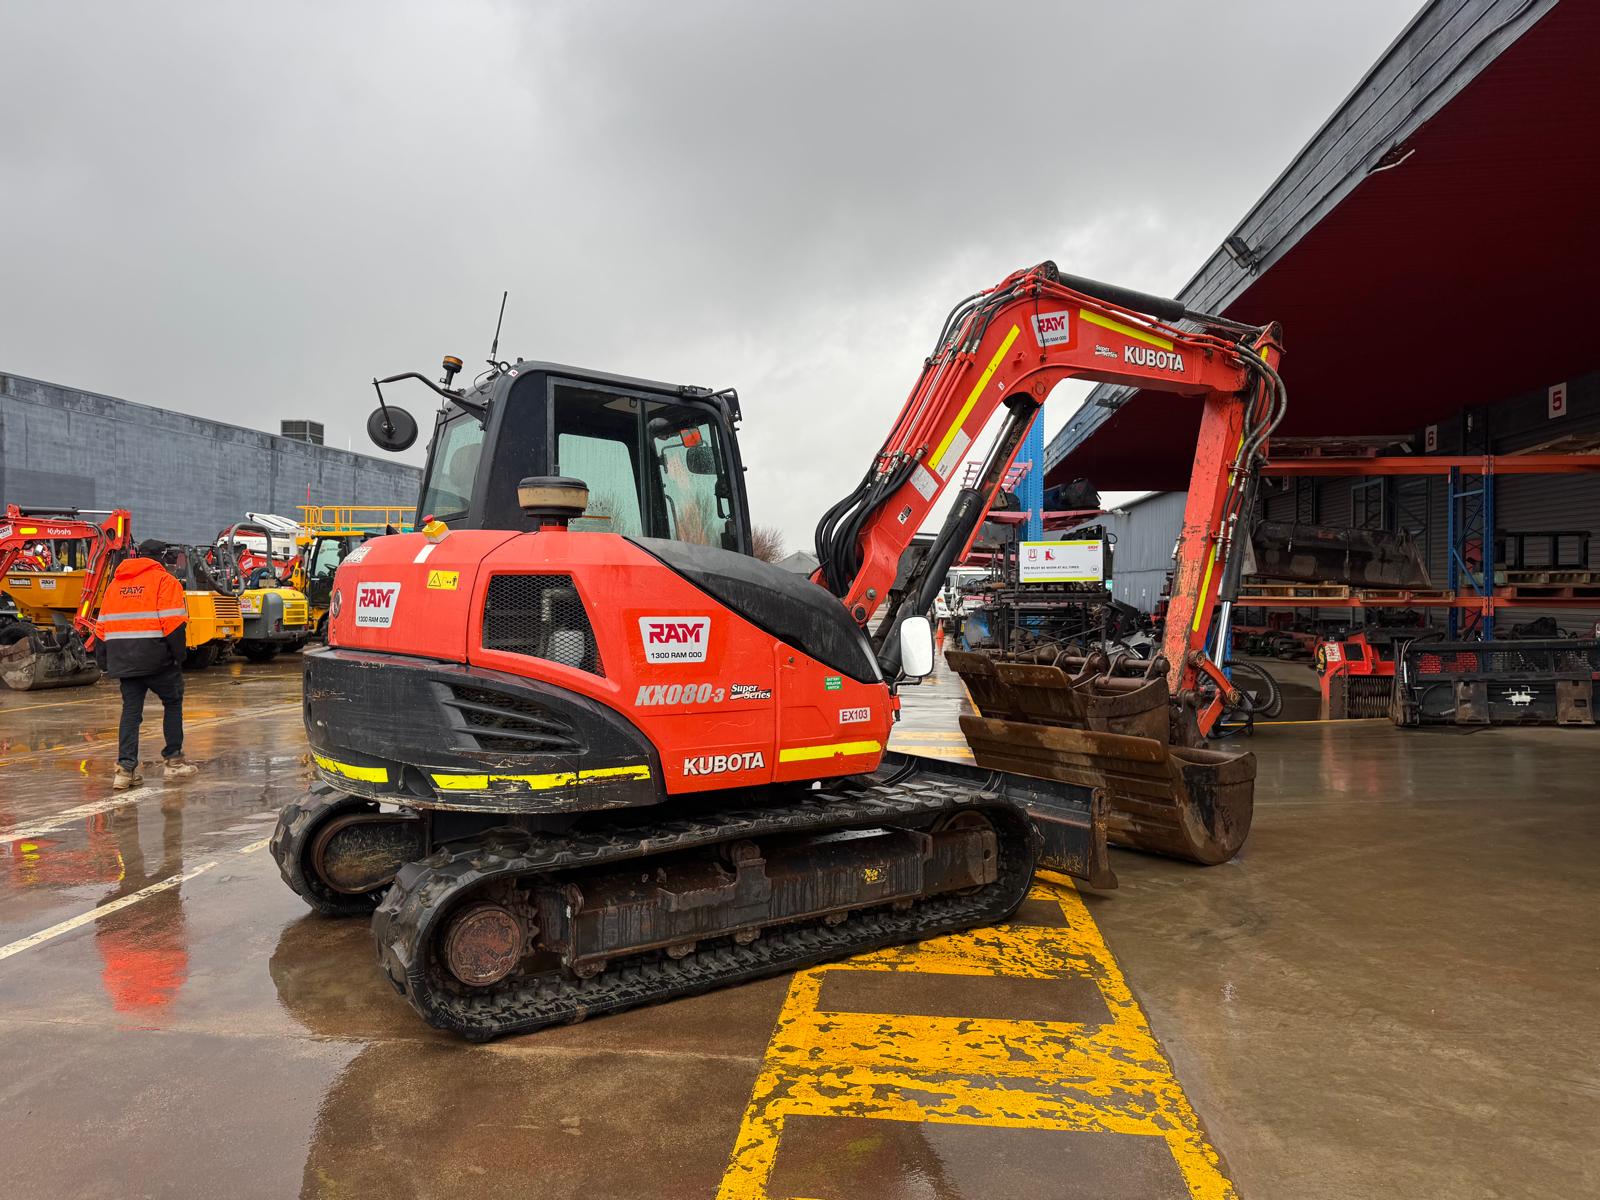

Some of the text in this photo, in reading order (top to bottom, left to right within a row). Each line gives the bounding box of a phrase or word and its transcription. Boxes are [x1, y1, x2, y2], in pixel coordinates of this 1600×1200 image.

[1037, 315, 1065, 333] RAM
[1095, 344, 1110, 352] Super
[1124, 345, 1184, 372] KUBOTA
[1552, 390, 1562, 411] 5
[1427, 431, 1434, 447] 6
[47, 527, 72, 536] Kubota
[120, 586, 145, 595] RAM
[359, 588, 395, 608] RAM
[648, 623, 705, 644] RAM
[634, 683, 726, 707] KX080-3
[731, 684, 758, 693] Super
[743, 691, 771, 700] Series
[842, 709, 868, 721] EX103
[683, 752, 765, 777] KUBOTA
